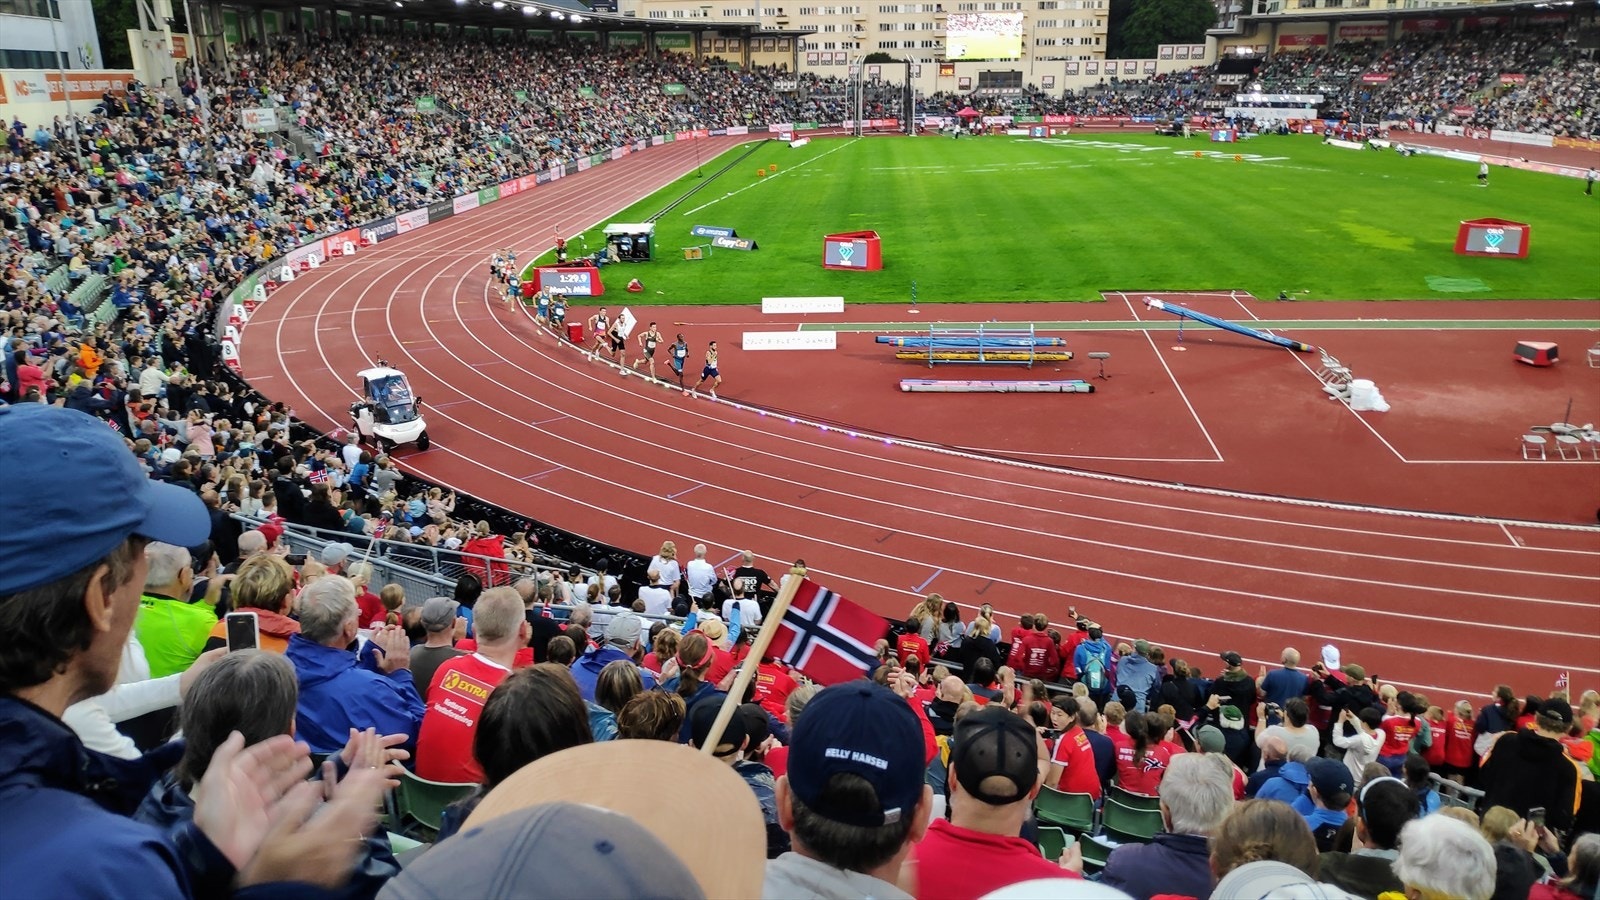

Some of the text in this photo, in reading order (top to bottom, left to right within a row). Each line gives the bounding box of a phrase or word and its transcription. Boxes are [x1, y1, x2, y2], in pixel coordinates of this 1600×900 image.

[717, 237, 749, 248] CopyCat
[560, 274, 587, 283] 1:29.9
[457, 680, 487, 699] EXTRA
[825, 748, 888, 770] HELLY HANSEN
